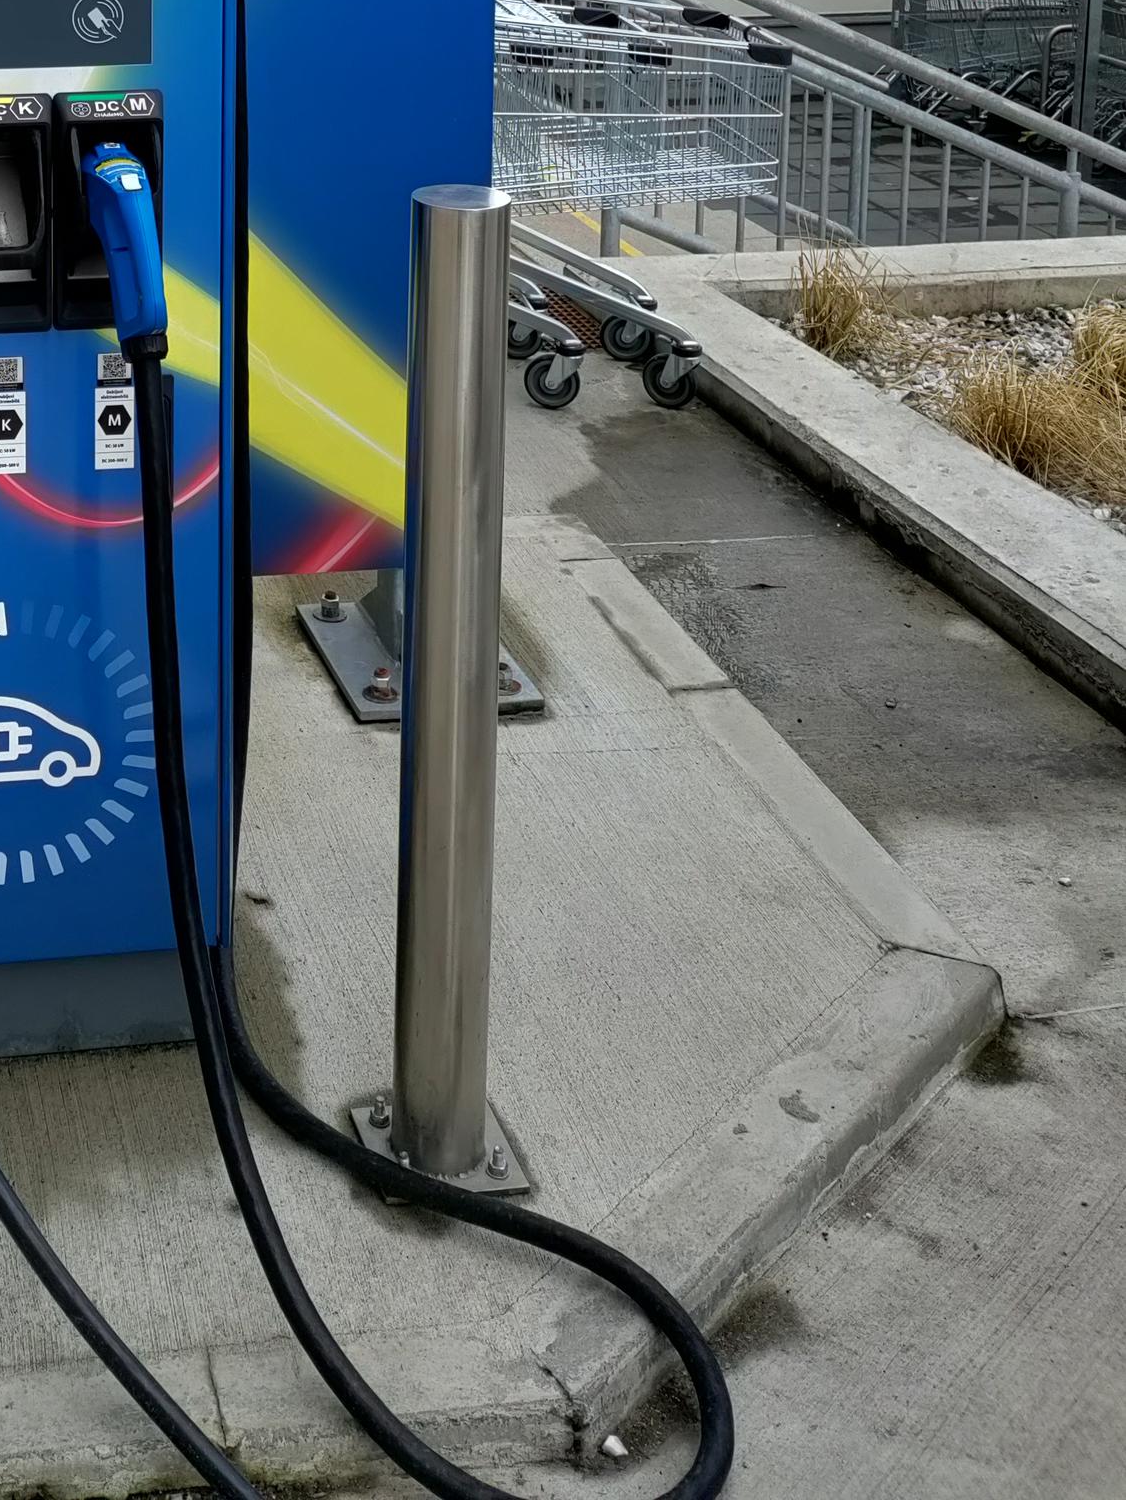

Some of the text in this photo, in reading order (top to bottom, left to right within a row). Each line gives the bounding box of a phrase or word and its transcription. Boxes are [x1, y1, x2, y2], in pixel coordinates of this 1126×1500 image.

[18, 101, 34, 115] K
[95, 97, 148, 112] DC M
[1, 419, 12, 432] K
[108, 414, 122, 427] M
